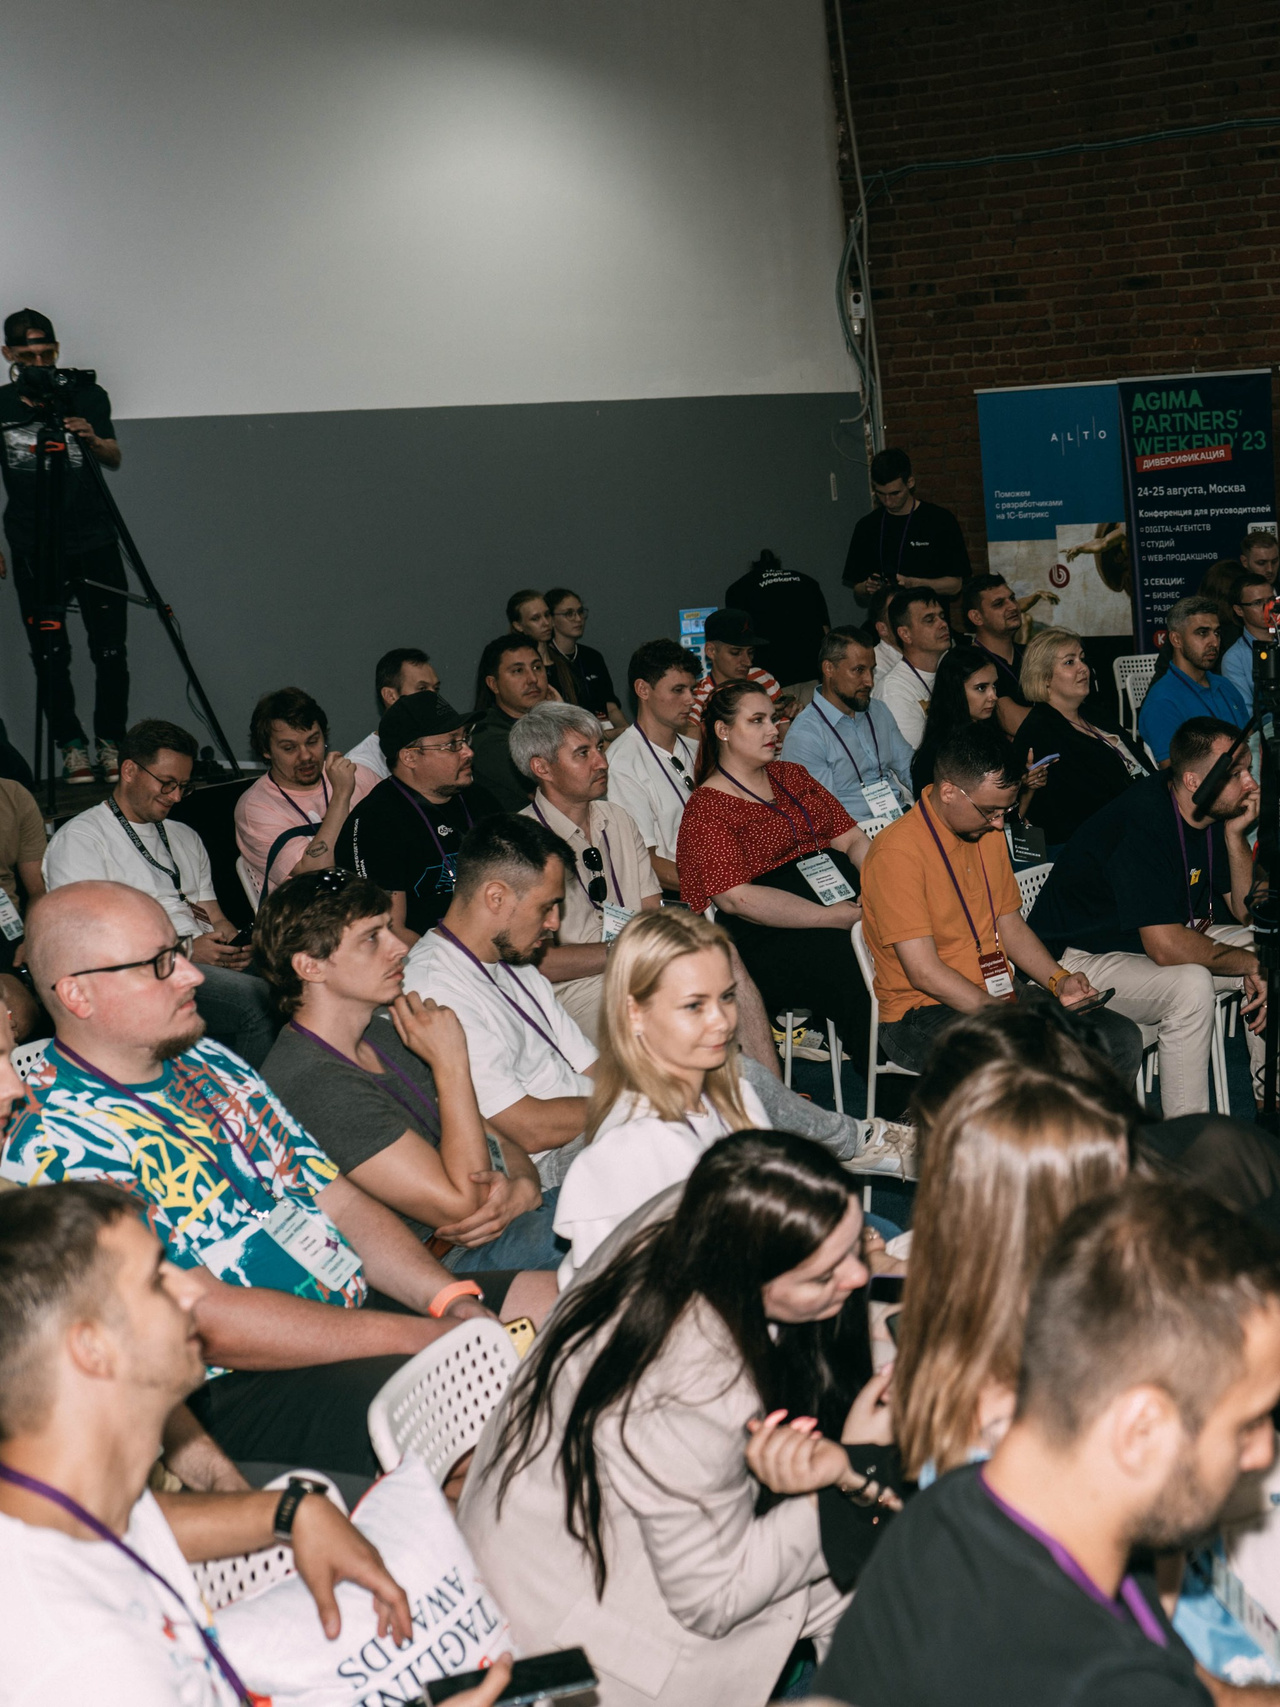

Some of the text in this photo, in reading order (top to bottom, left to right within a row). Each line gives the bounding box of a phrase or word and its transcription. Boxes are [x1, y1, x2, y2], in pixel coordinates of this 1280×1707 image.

[1132, 389, 1204, 411] AGIMA
[1132, 409, 1242, 434] PARTNERS'
[1142, 449, 1226, 470] ДИВЕРСИФИКАЦИЯ
[994, 490, 1031, 498] Поможем
[1137, 483, 1246, 497] 24-25 августа, Москва
[1002, 500, 1064, 510] разработчиками
[1138, 504, 1271, 518] Конференция для руководителей
[1144, 523, 1212, 533] DIGITAL-АГЕНТСТВ
[1146, 538, 1175, 549] СТУДИЙ
[1147, 552, 1218, 562] WEB-ПРОДАКШНОВ
[759, 577, 800, 588] Weekend
[1143, 577, 1186, 587] 3 СЕКЦИИ:
[1152, 591, 1180, 599] БИЗНЕС
[336, 1566, 466, 1690] AWADS
